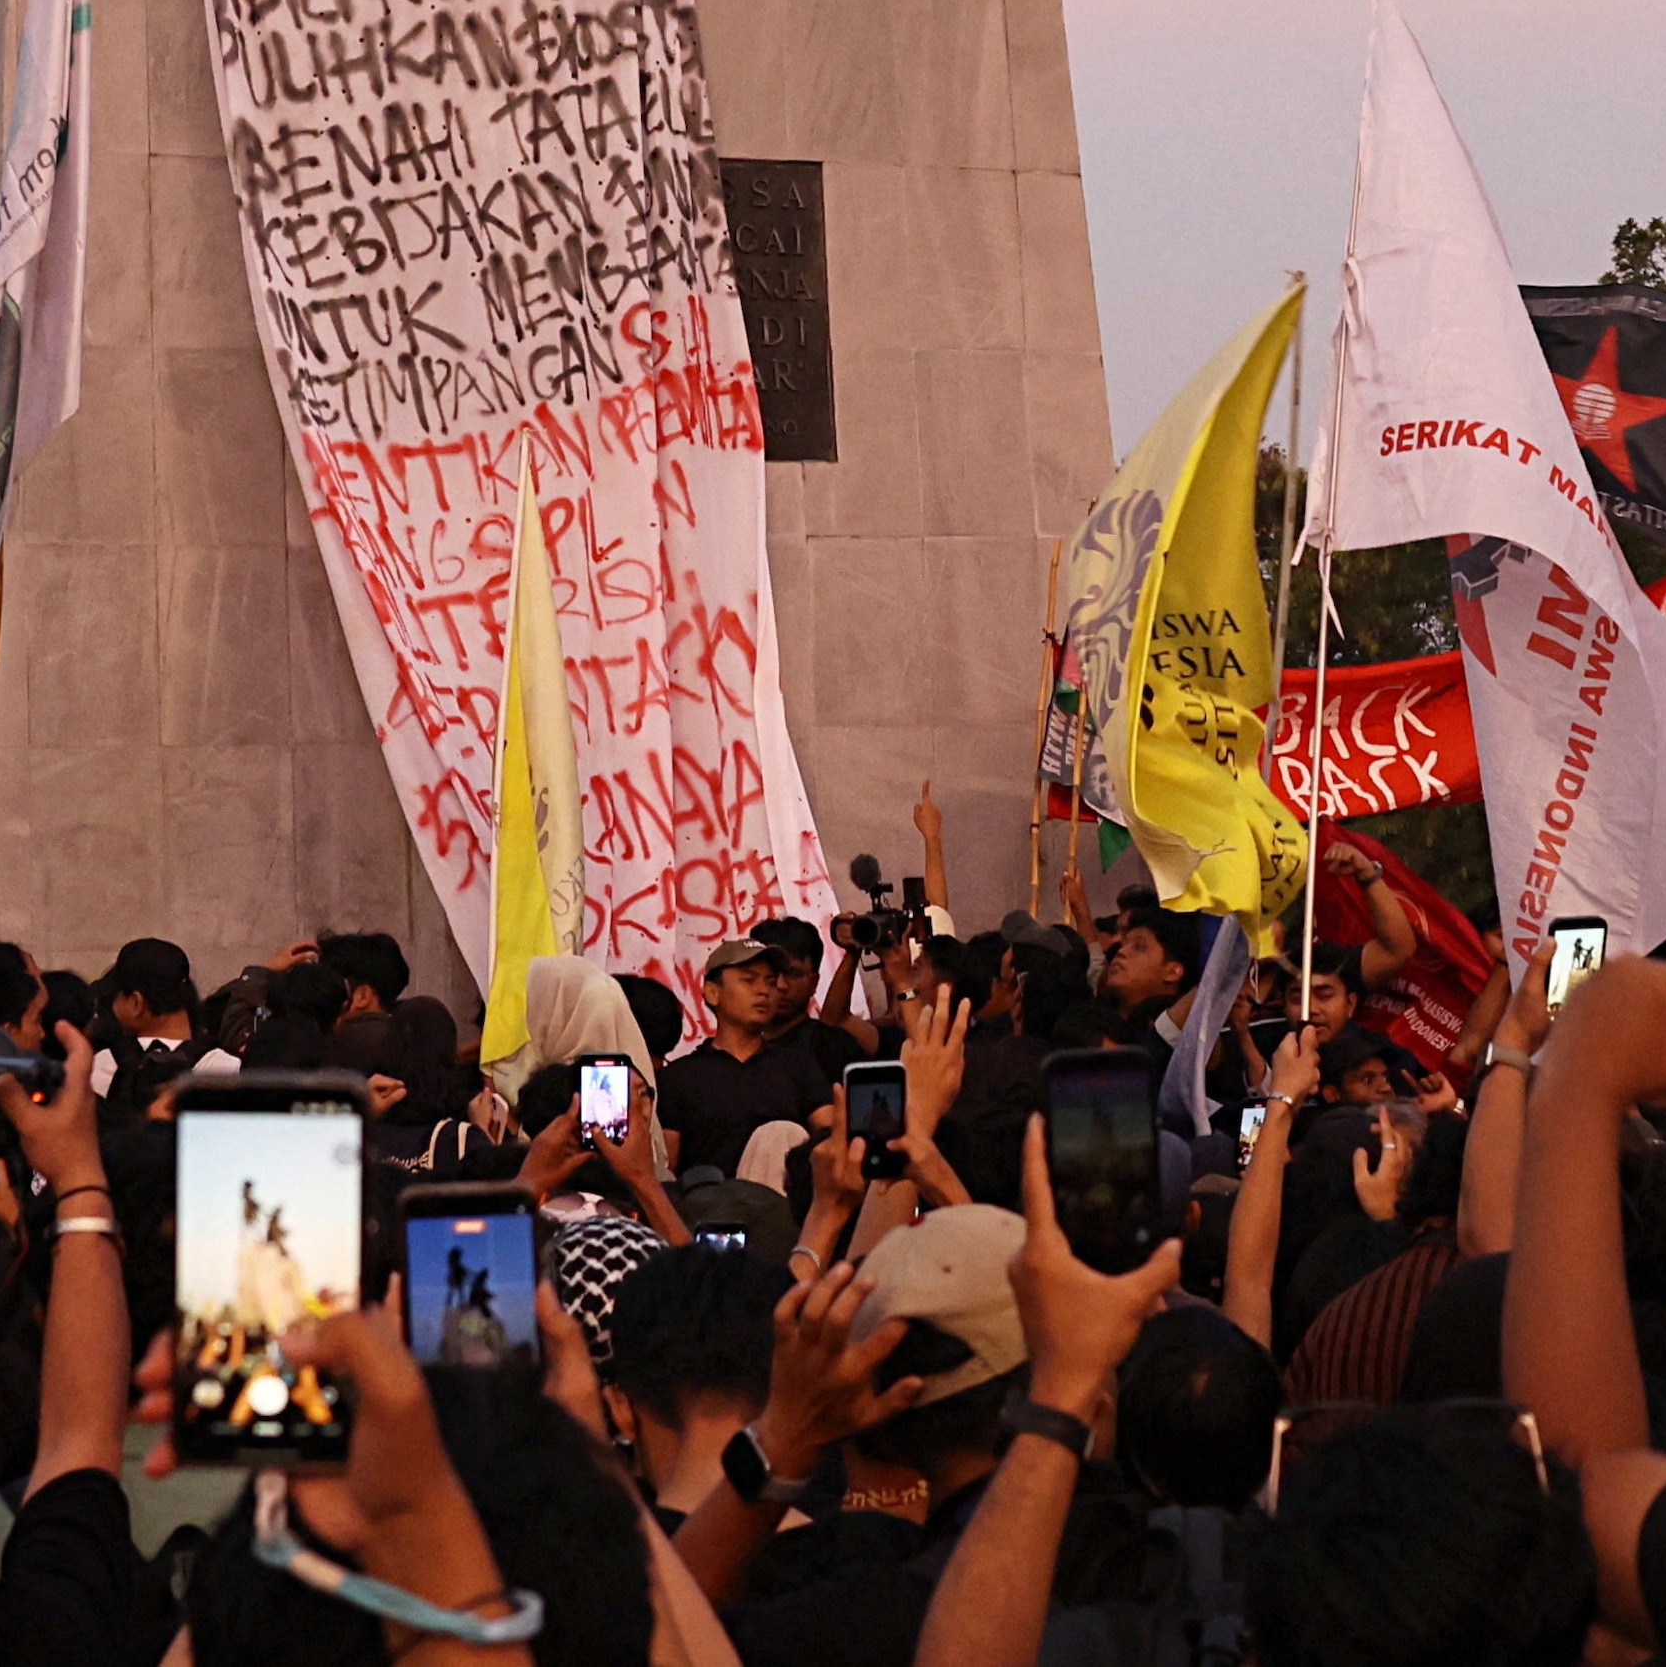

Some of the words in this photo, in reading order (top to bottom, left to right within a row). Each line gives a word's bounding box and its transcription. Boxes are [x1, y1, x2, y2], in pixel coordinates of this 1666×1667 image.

[489, 76, 641, 168] TATA
[1380, 419, 1541, 466] SERIKAT
[1271, 679, 1437, 760] BACK
[1403, 1006, 1456, 1052] INDONESI
